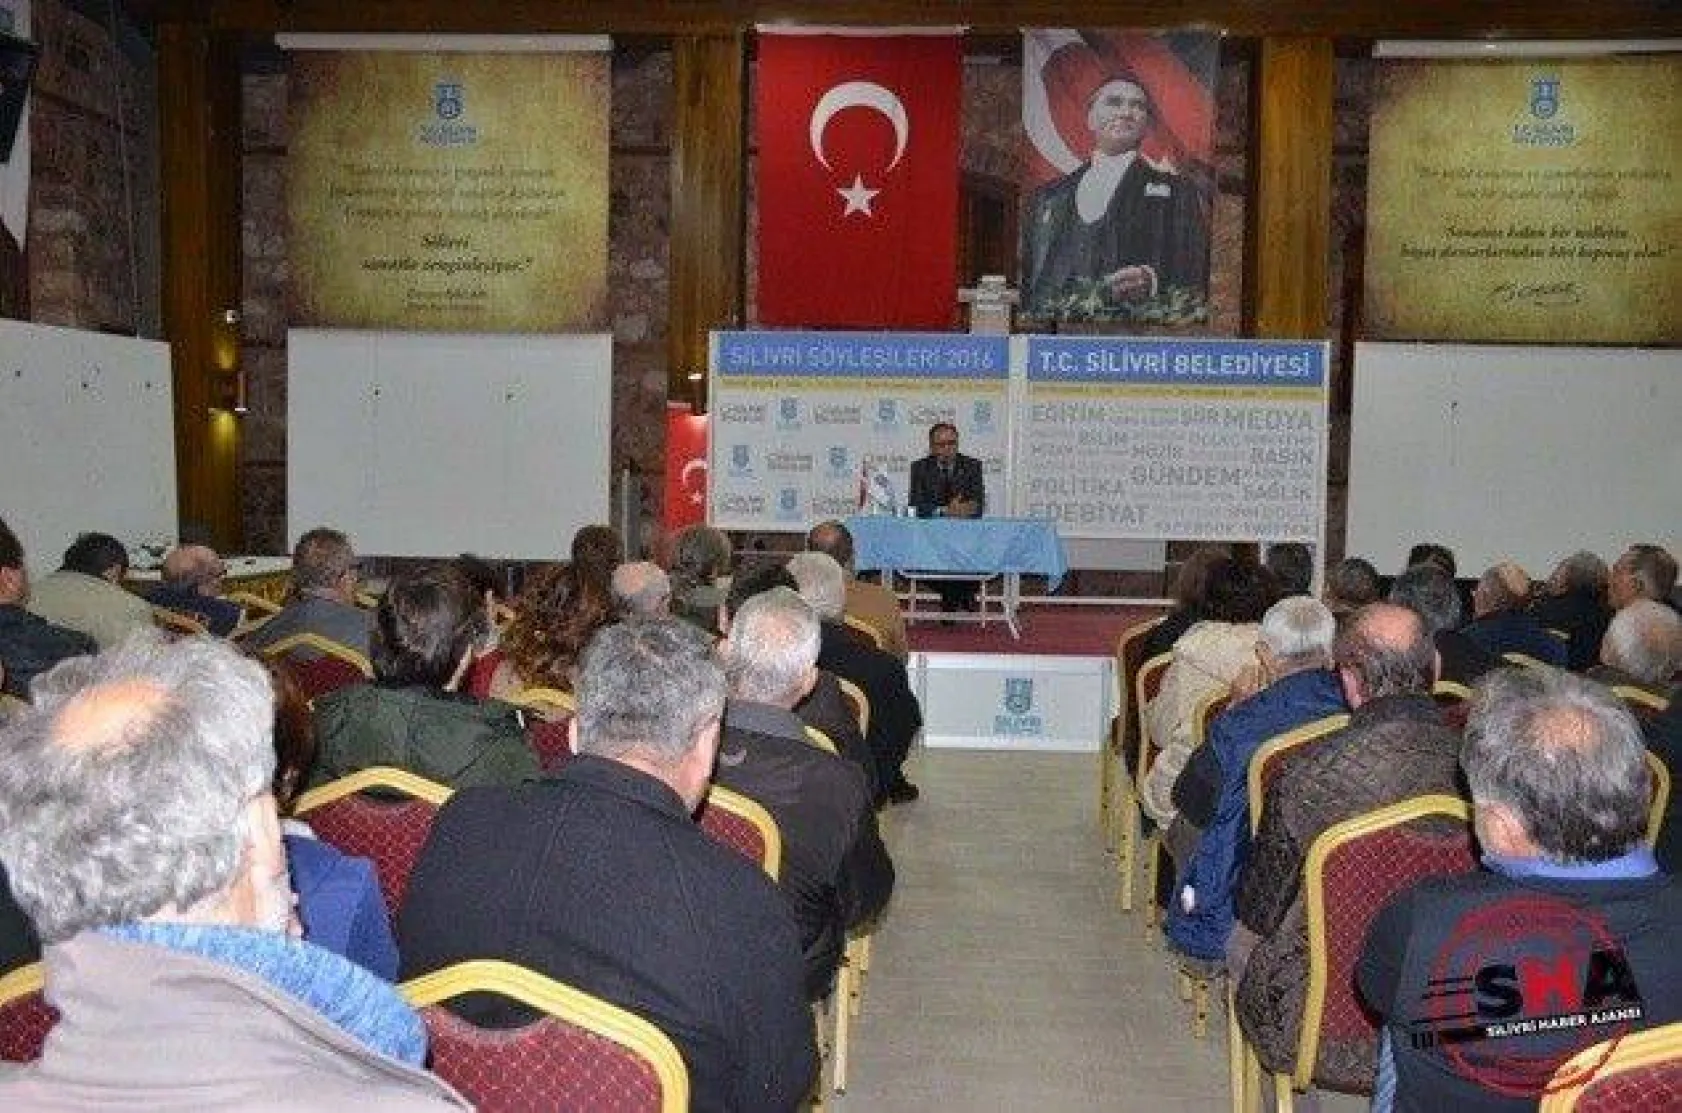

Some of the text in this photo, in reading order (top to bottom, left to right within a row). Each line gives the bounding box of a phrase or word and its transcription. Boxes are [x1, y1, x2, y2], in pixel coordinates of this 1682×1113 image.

[1040, 351, 1079, 372] T.C.
[1174, 351, 1310, 377] BELEDİYESİ
[1130, 462, 1240, 486] GÜNDEM
